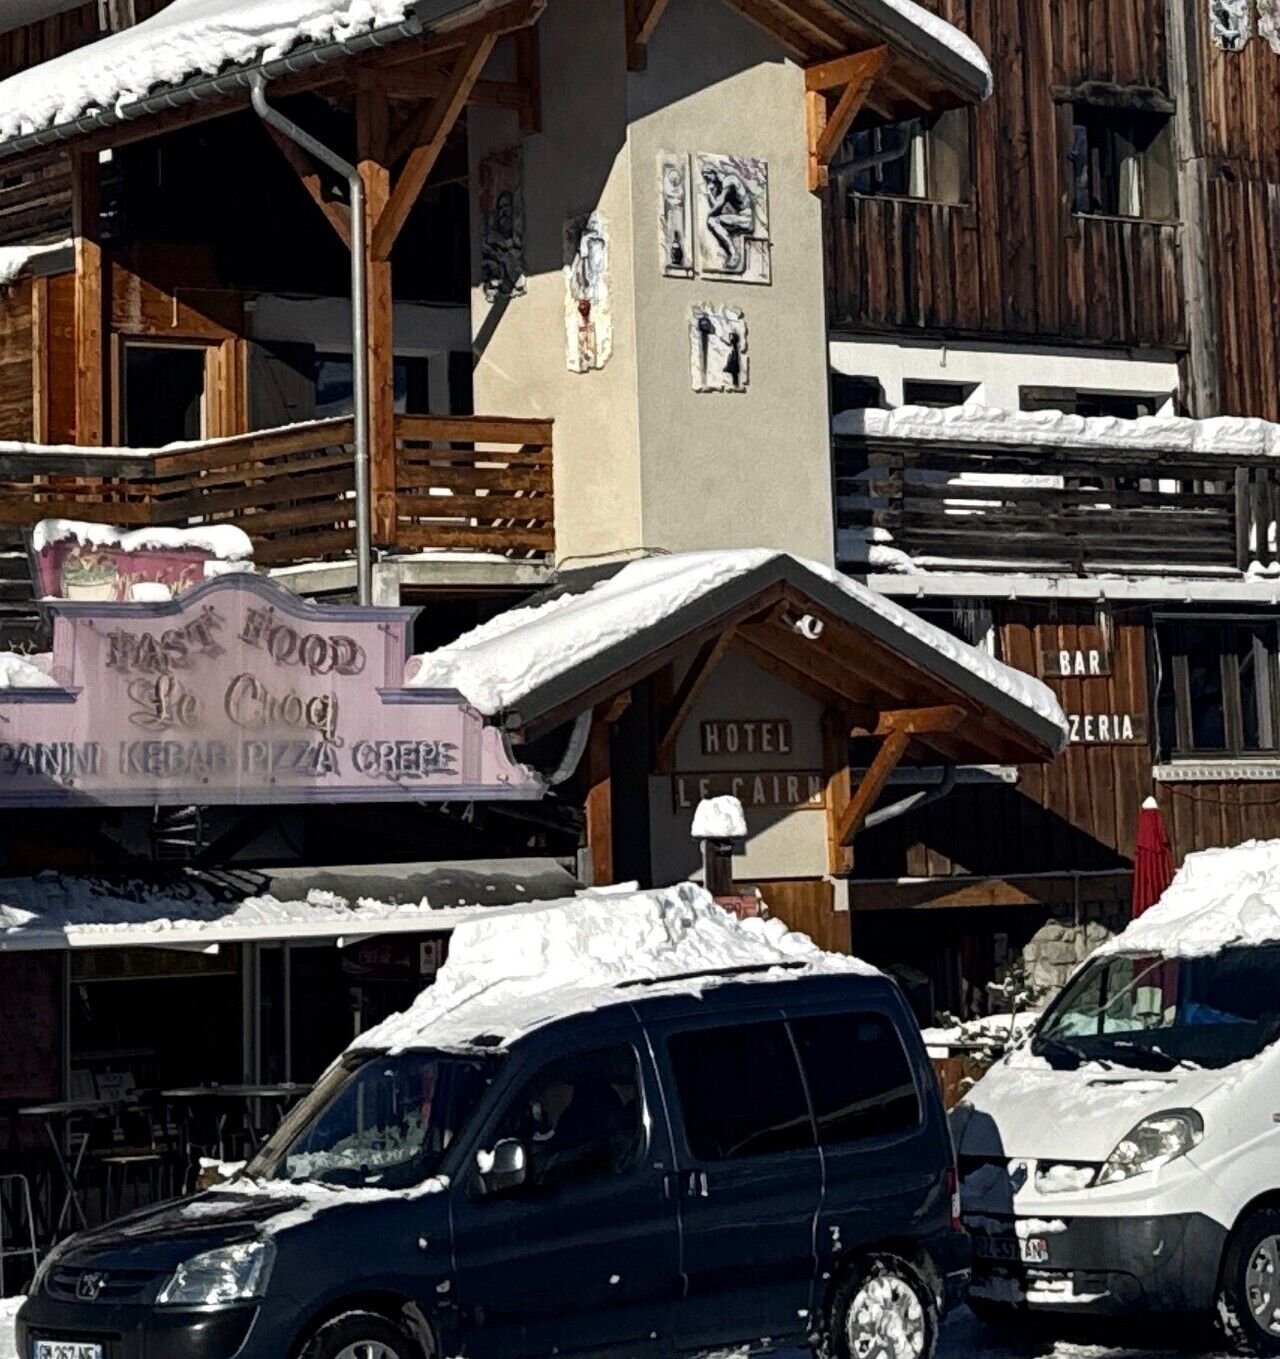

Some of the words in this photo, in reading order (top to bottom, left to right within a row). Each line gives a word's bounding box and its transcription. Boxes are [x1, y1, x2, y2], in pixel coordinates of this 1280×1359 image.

[103, 605, 226, 673] FAST
[238, 607, 366, 676] FOOD
[1060, 650, 1100, 675] BAR
[128, 673, 203, 731] Le
[224, 672, 345, 748] Croq
[705, 723, 790, 753] HOTEL
[1068, 714, 1134, 741] ZERIA
[238, 740, 342, 778] PIZZA
[351, 739, 460, 782] CREPE
[678, 777, 710, 807] LE
[732, 775, 821, 805] CAIRN
